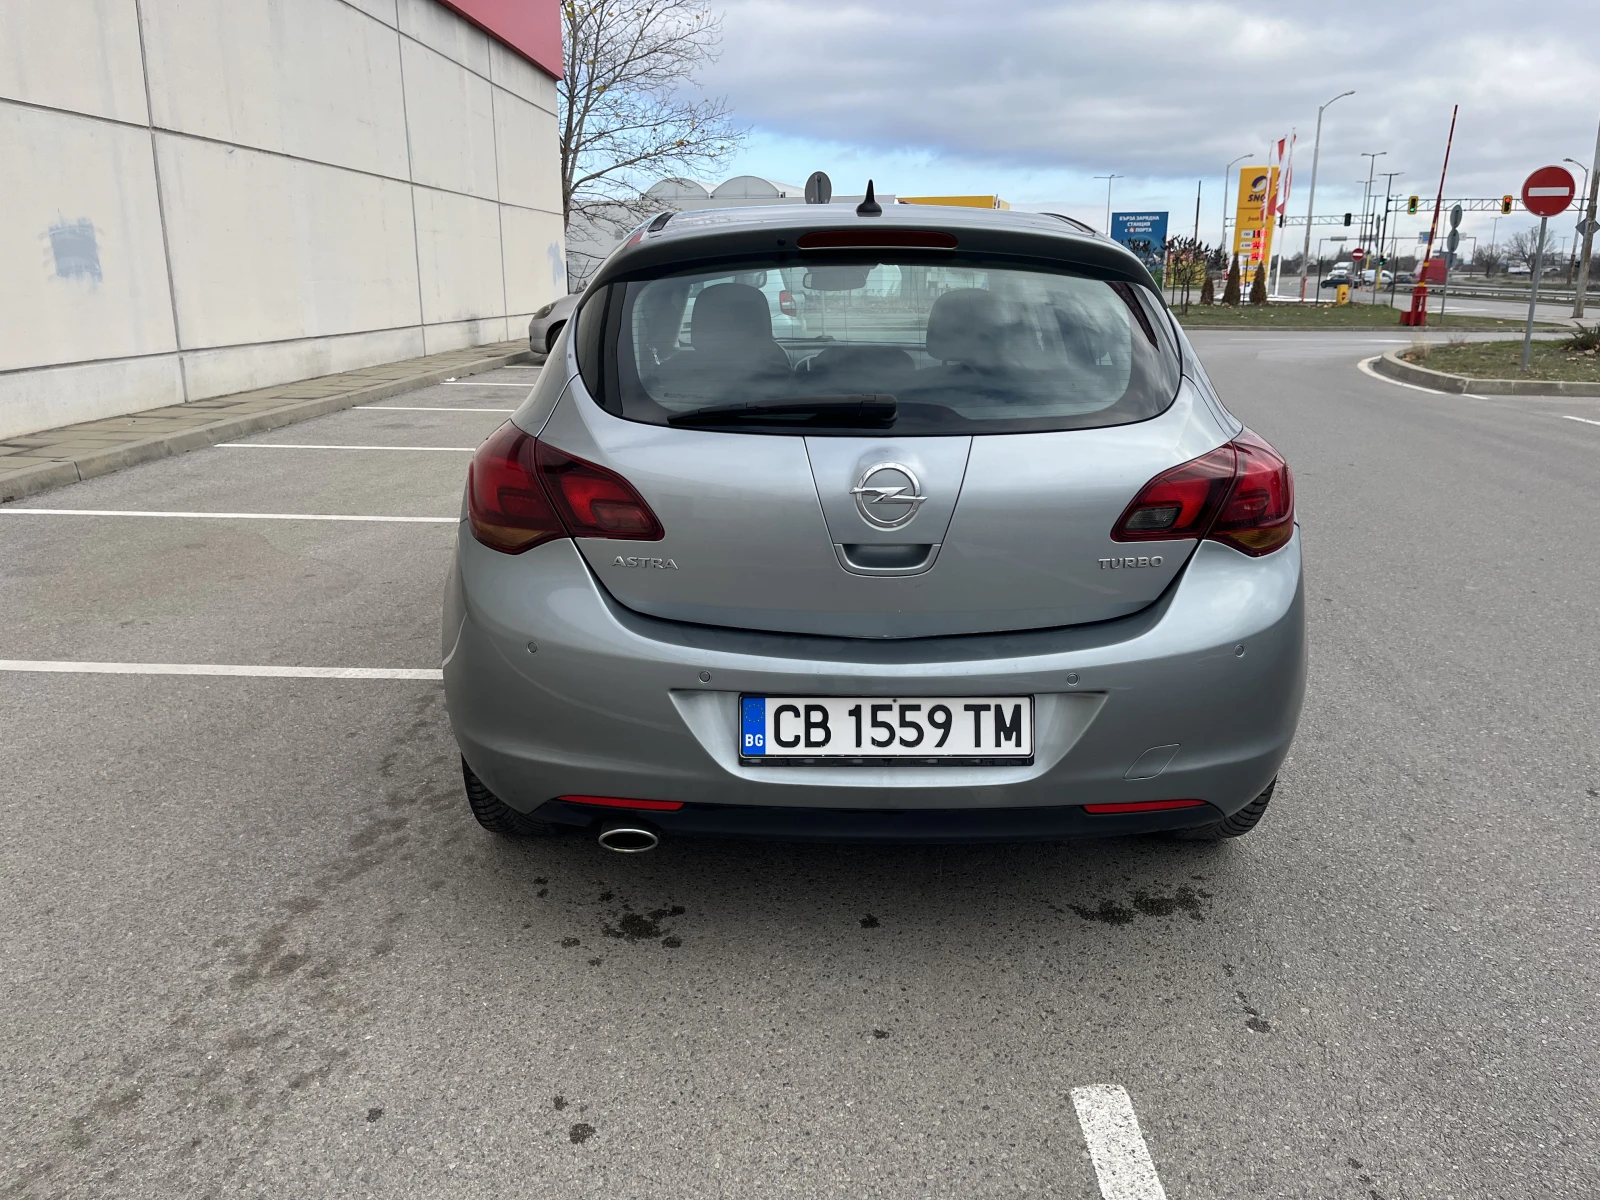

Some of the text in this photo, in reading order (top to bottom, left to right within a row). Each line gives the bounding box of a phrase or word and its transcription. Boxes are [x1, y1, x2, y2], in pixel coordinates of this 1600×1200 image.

[611, 555, 679, 570] ASTRA
[1098, 555, 1164, 569] TURBO
[774, 704, 1022, 748] CB 1559 TM
[745, 734, 763, 747] BG
